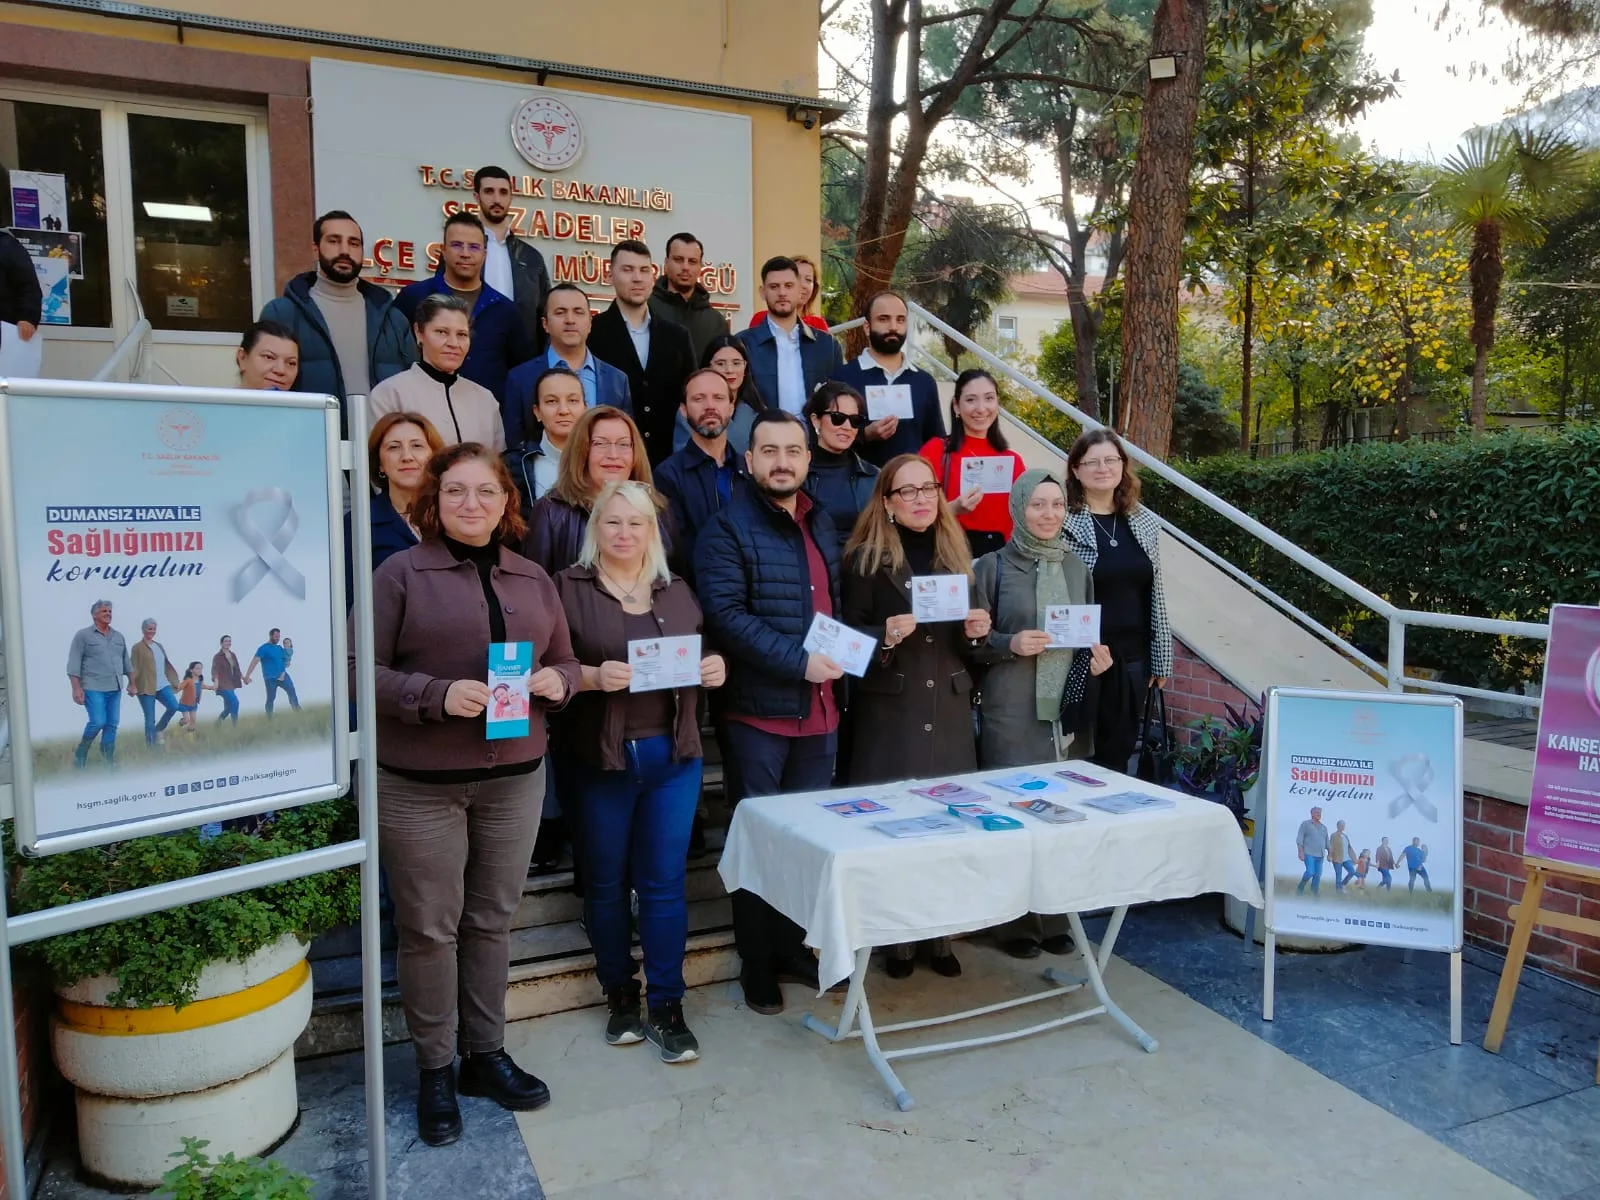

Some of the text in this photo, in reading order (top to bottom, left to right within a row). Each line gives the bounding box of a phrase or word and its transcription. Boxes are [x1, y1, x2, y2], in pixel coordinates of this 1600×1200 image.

[419, 164, 673, 212] T.C. SLIK BAKANLIĞI
[442, 200, 646, 245] ZADELER
[49, 506, 200, 522] DUMANSIZ HAVA İLE
[47, 527, 203, 557] Sağlığımızı
[46, 555, 205, 587] koruyalım
[1547, 733, 1600, 755] KANSE
[1292, 756, 1373, 769] DUMANSIZ HAVA İLE
[1578, 755, 1600, 773] HA
[1291, 767, 1375, 786] Sağlığımızı
[76, 790, 157, 810] hsgm.saglik.gov.tr
[1289, 782, 1375, 802] koruyalım
